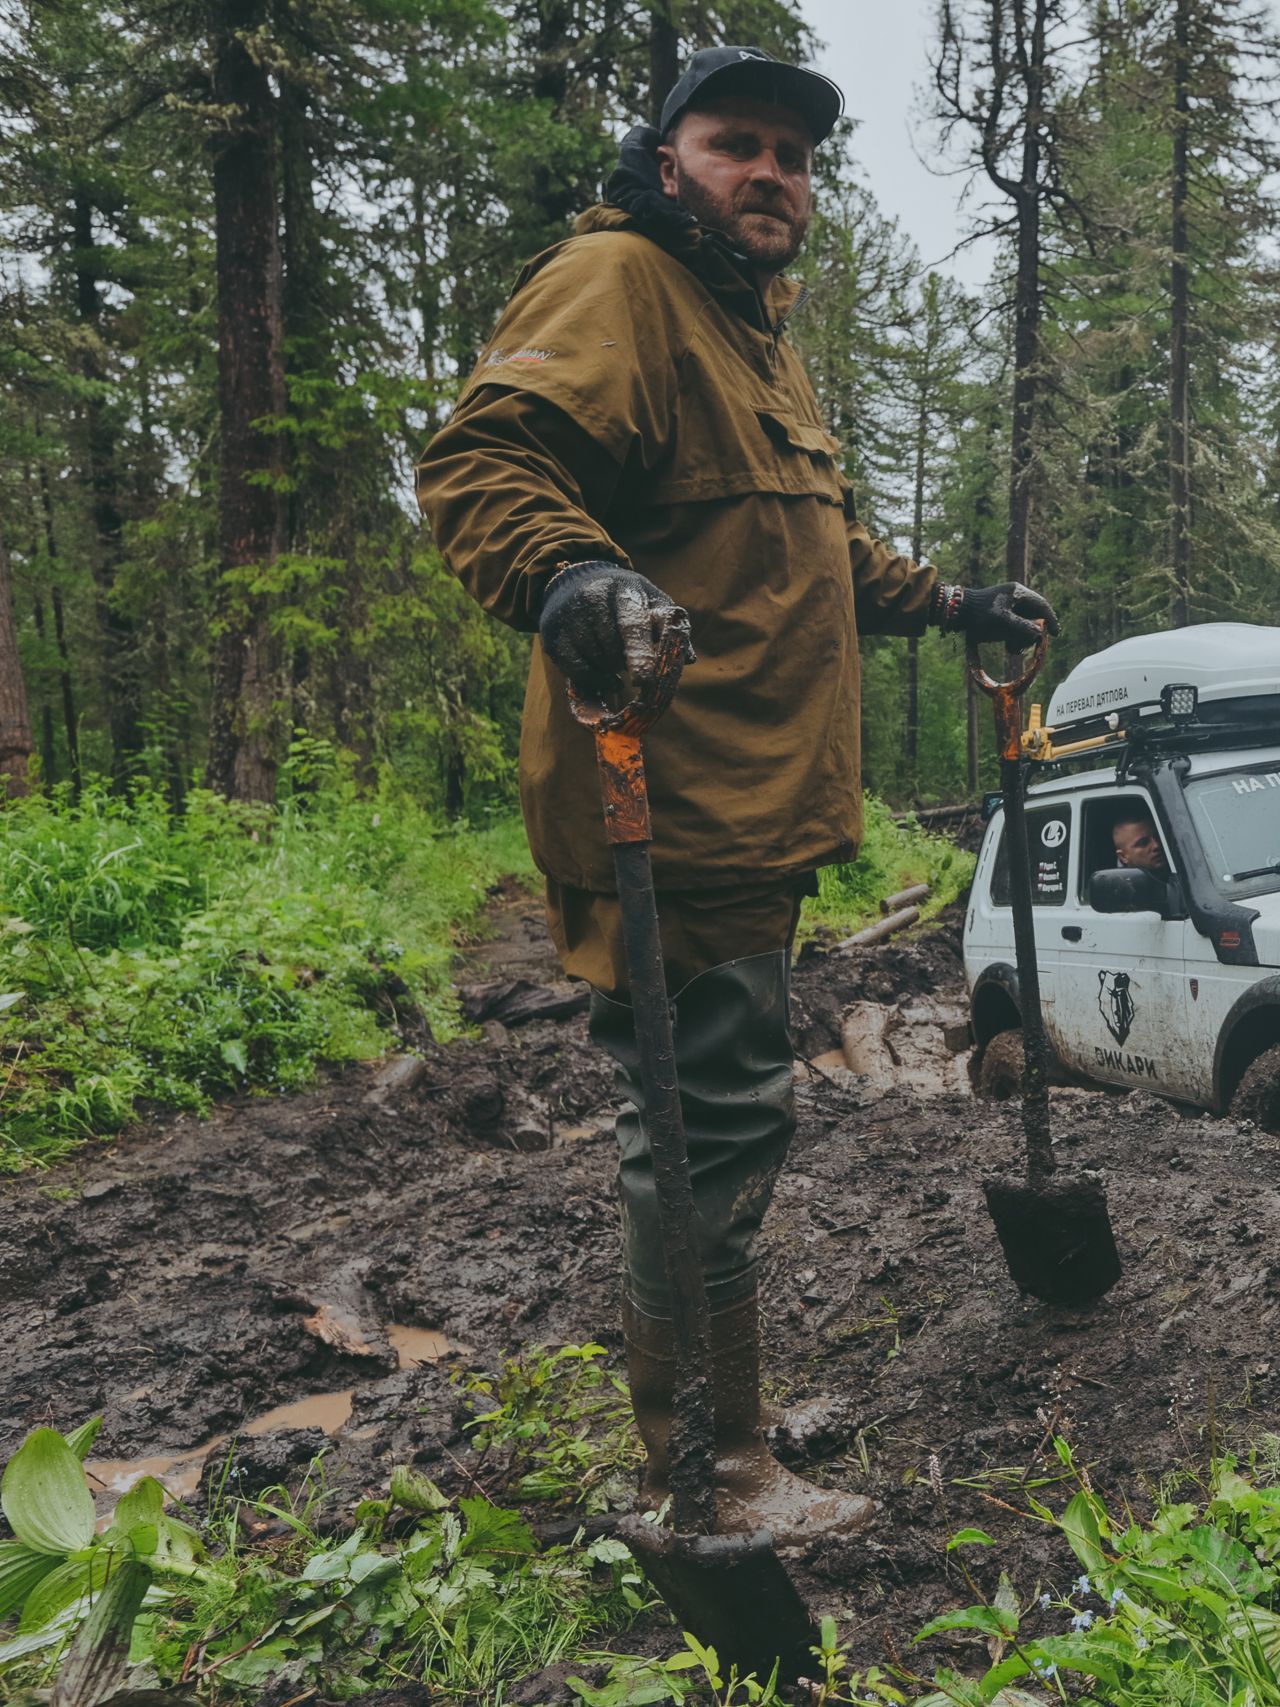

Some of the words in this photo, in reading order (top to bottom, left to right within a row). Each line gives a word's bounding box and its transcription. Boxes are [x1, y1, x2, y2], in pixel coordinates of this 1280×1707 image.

[1066, 695, 1095, 714] ПЕРЕВАЛ
[1097, 687, 1128, 708] ДЯТЛОВА
[1231, 777, 1266, 795] НА
